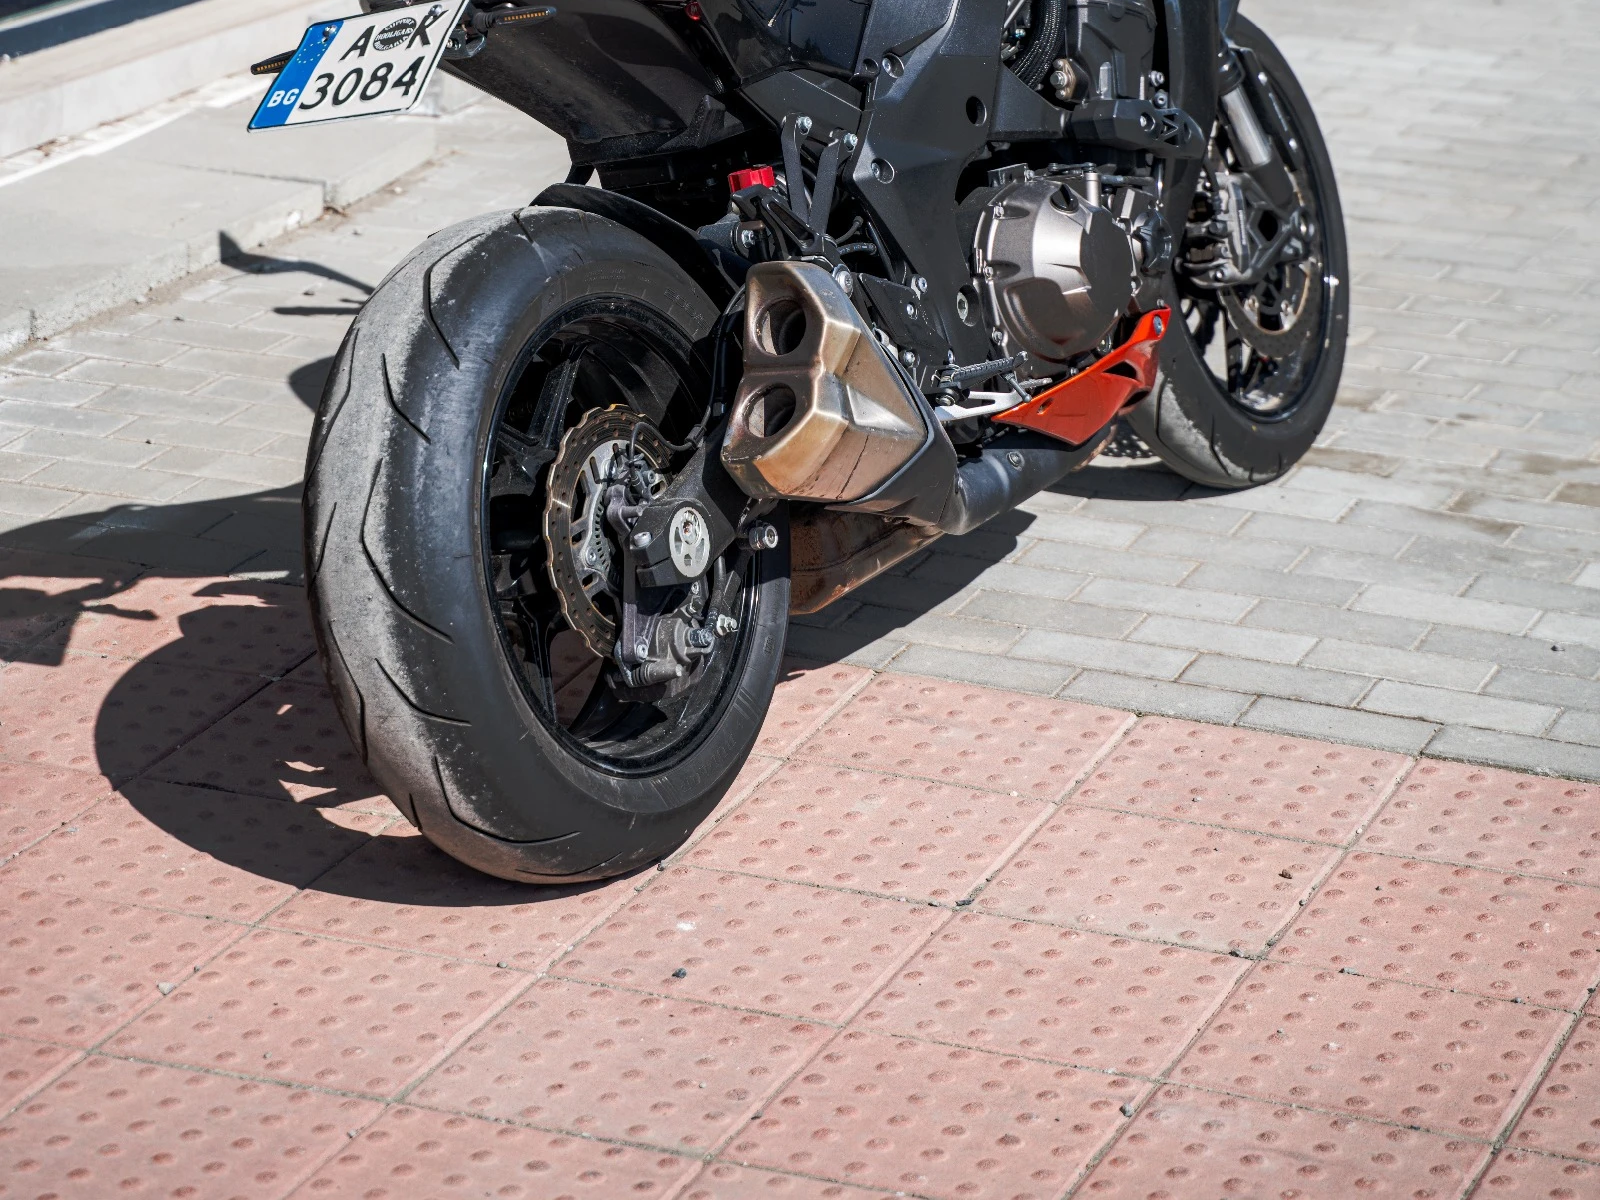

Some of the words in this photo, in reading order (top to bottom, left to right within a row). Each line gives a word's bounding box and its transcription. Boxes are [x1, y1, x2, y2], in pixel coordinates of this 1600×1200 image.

[338, 25, 376, 62] A
[406, 8, 449, 50] K
[267, 88, 300, 108] BG
[299, 55, 426, 110] 3084
